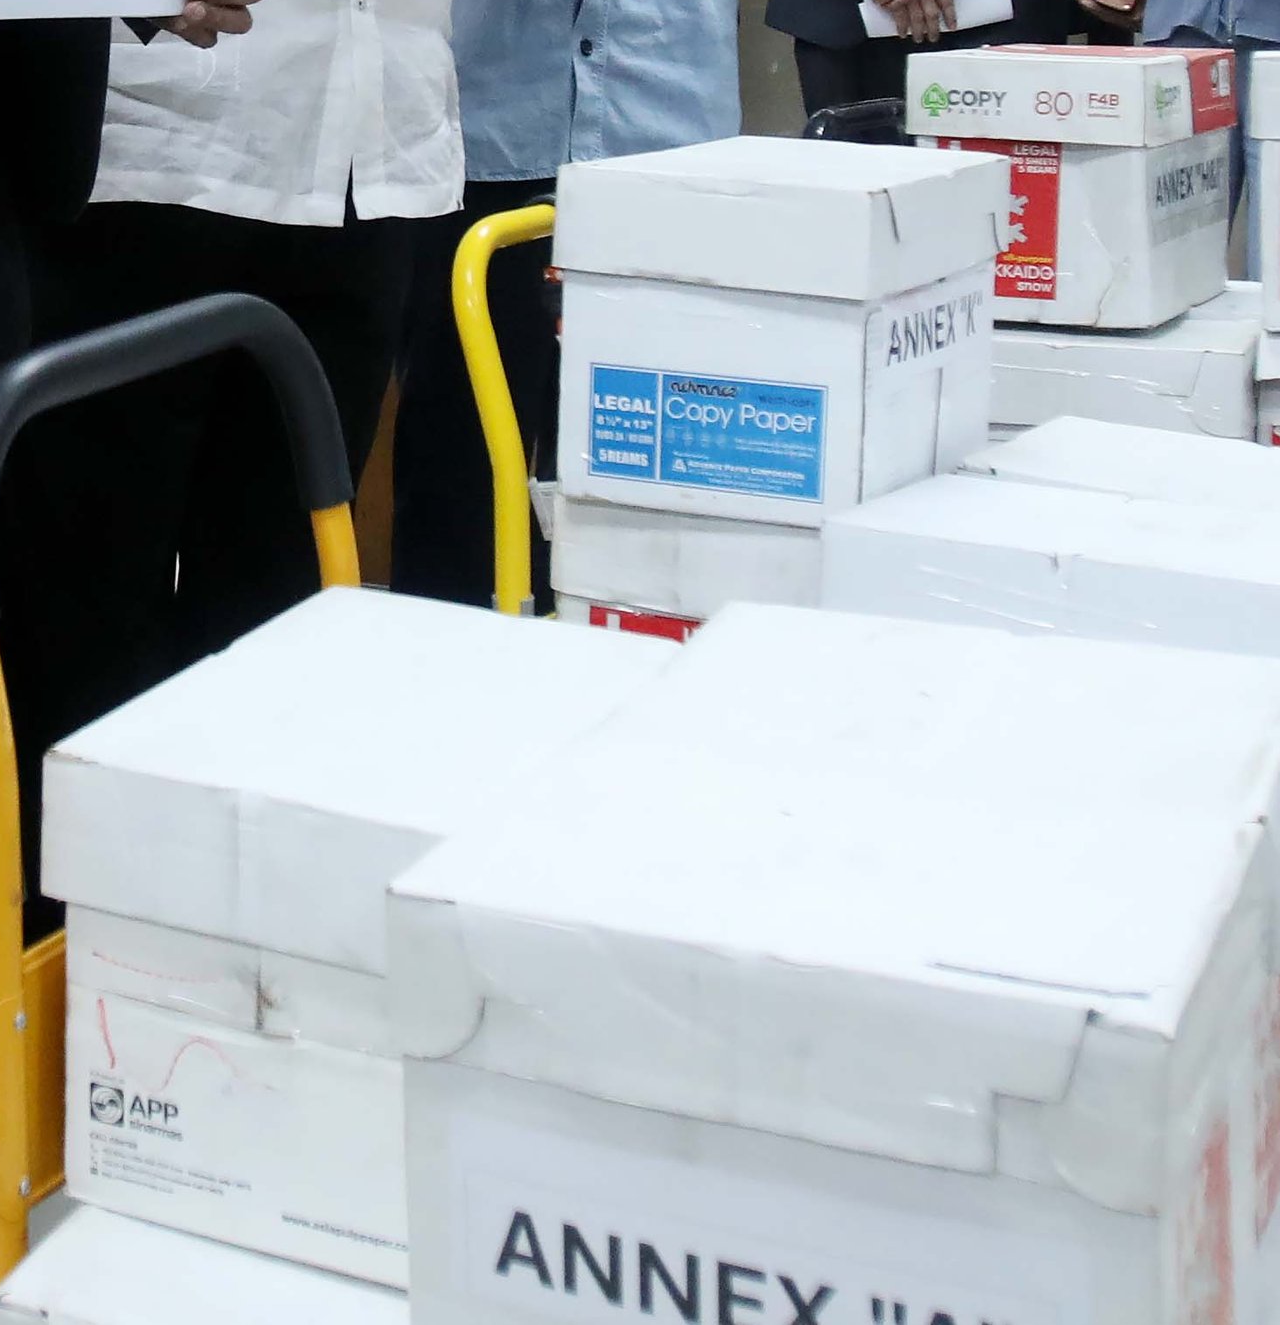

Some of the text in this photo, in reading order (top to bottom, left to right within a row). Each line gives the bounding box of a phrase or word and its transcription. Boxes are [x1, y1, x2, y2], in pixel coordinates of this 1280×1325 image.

[947, 89, 1007, 107] COPY
[1034, 90, 1074, 116] 80
[1014, 144, 1059, 156] LEGAL
[886, 299, 957, 368] ANNEX
[594, 393, 656, 415] LEGAL
[665, 396, 817, 435] Copy Paper
[129, 1094, 179, 1125] APP
[494, 1209, 837, 1325] ANNEX
